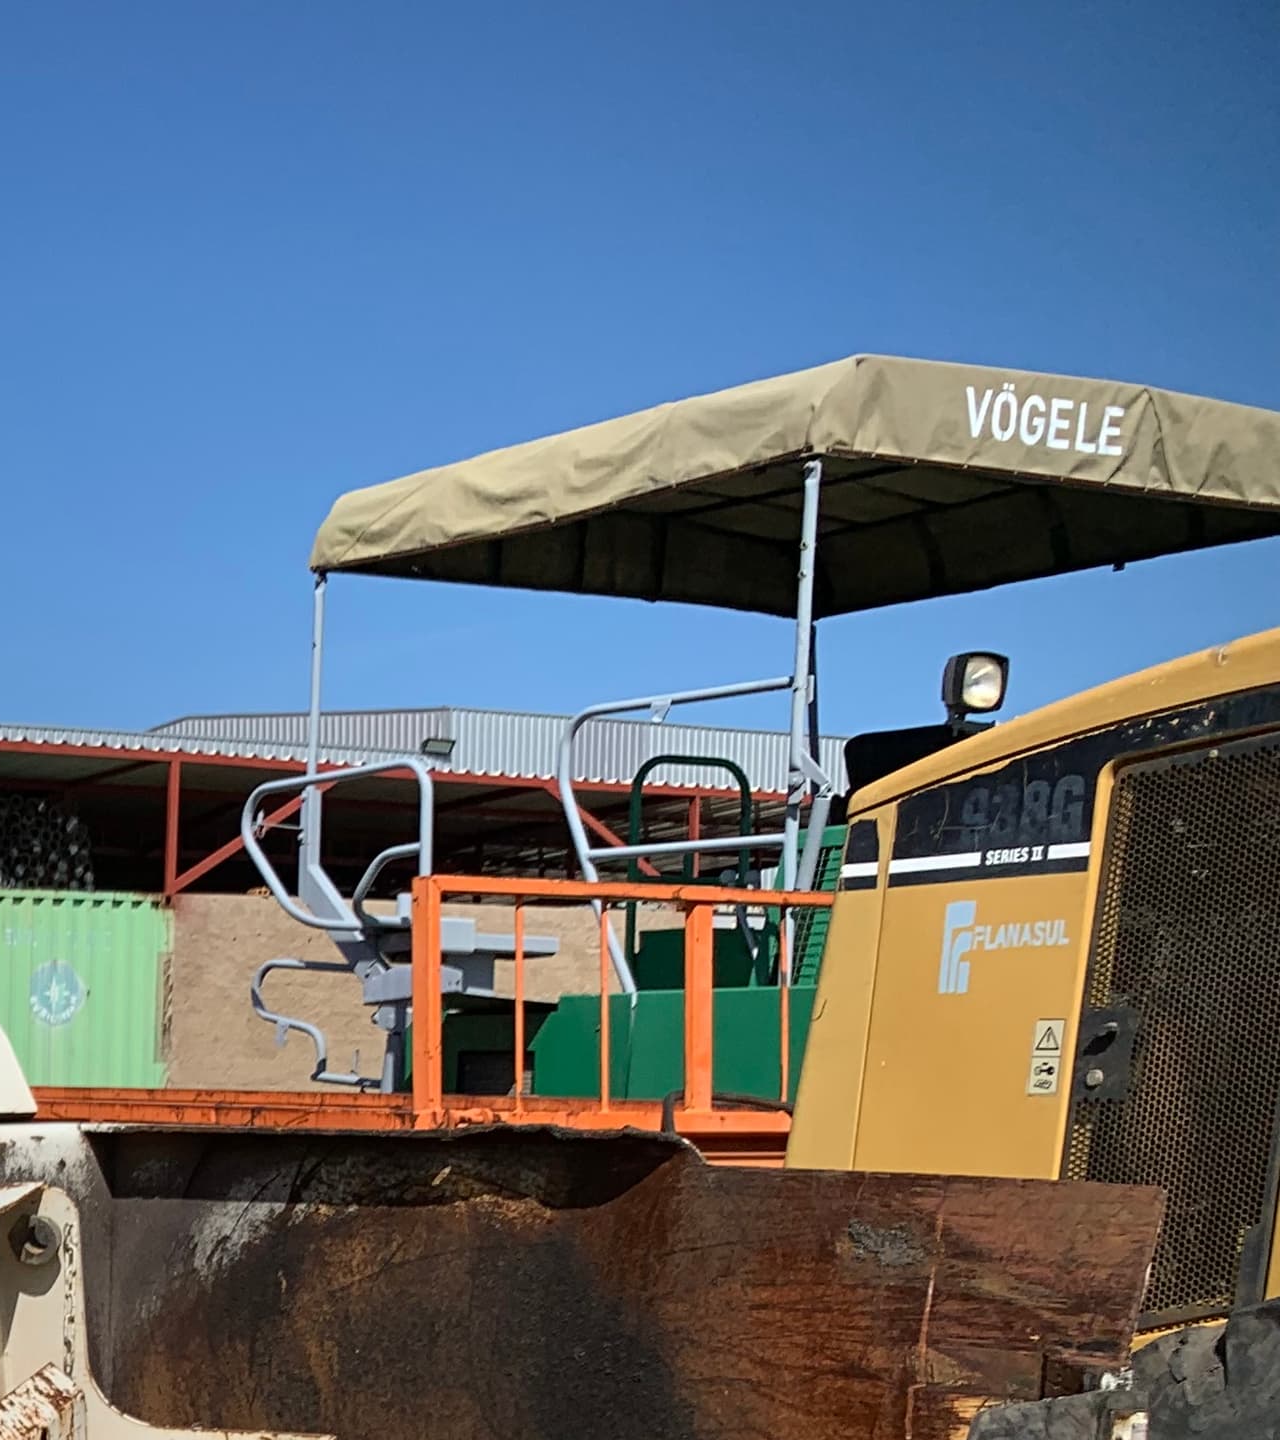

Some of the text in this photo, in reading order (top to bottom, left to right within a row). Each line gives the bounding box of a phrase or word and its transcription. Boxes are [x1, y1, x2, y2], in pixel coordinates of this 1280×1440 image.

[966, 383, 1125, 455] VÖGELE
[985, 846, 1044, 866] SERIES II
[972, 919, 1070, 950] PLANASUL
